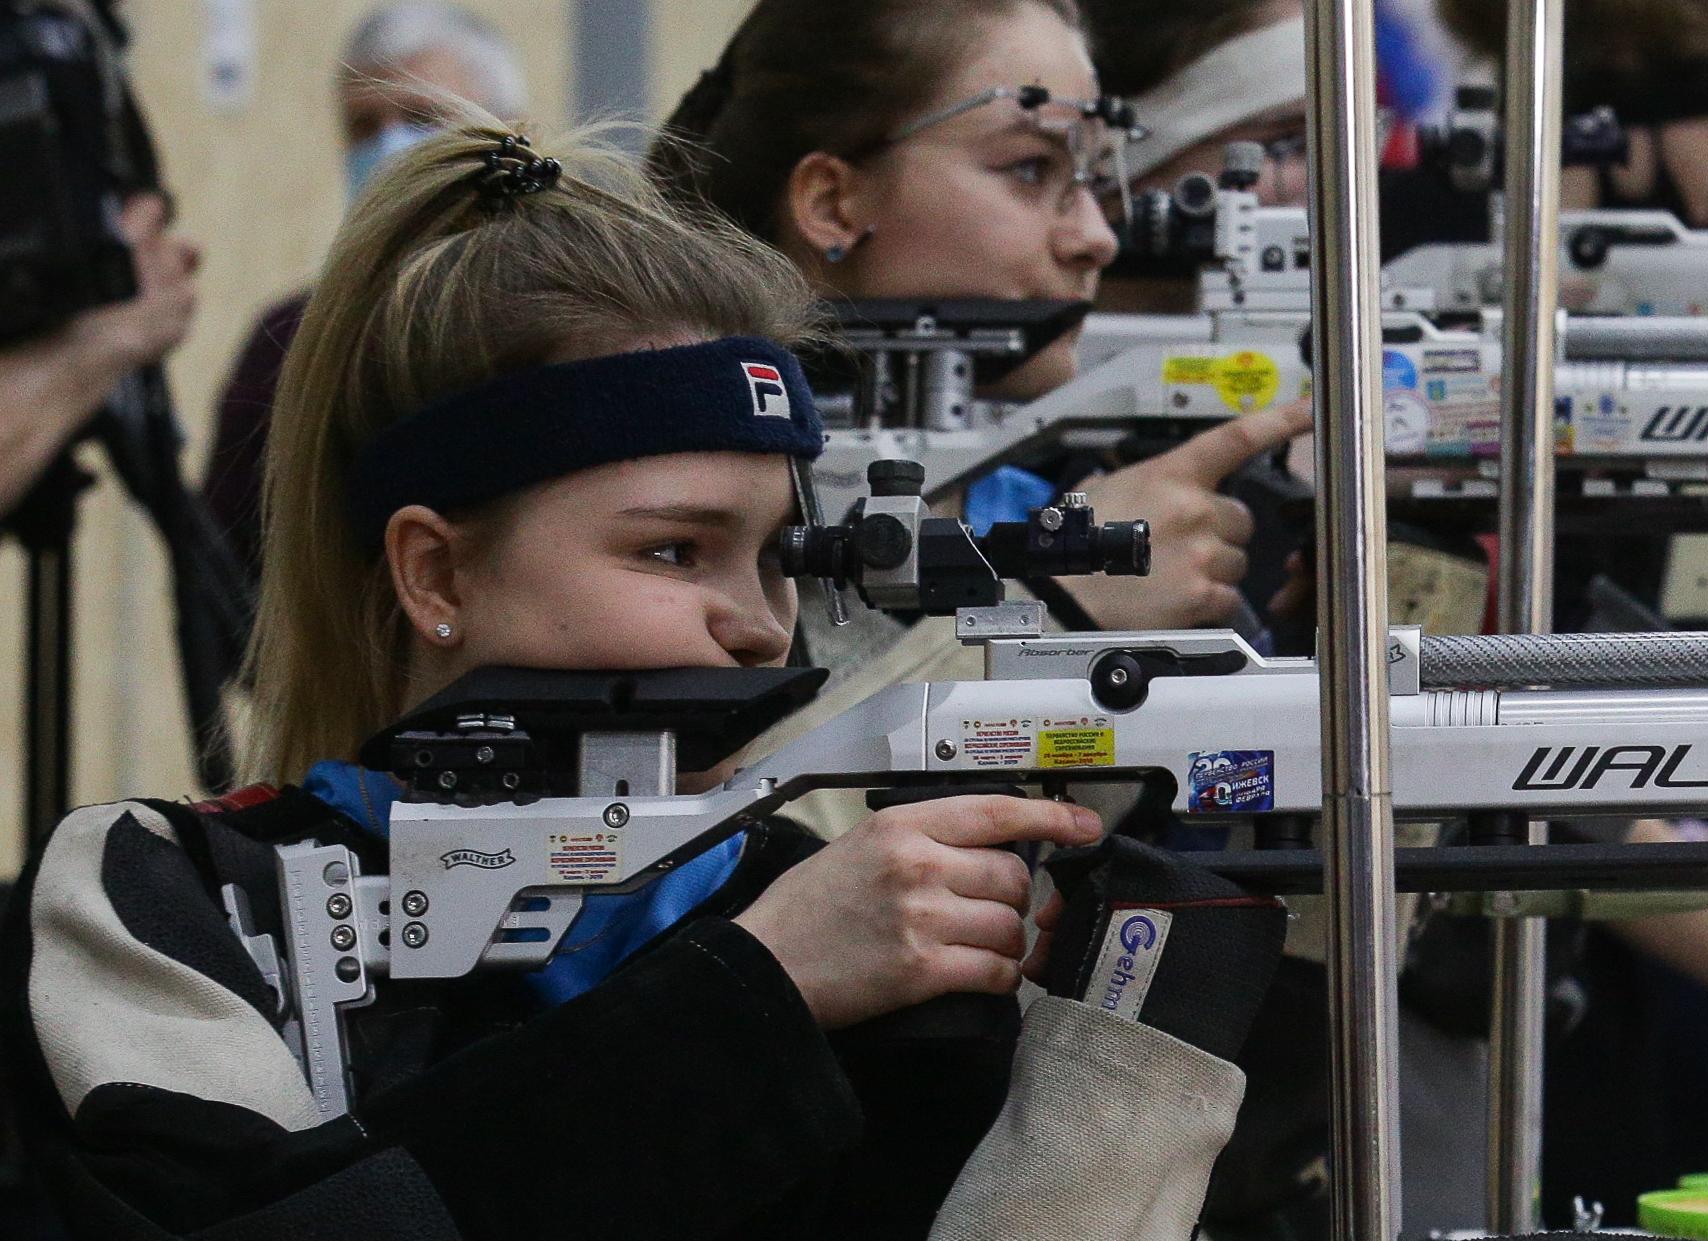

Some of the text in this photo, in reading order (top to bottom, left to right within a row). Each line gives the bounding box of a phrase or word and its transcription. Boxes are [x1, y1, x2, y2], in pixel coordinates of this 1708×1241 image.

[1017, 648, 1095, 657] Absorber
[1232, 775, 1270, 791] ИЖЕВСК
[450, 852, 506, 866] WALTHER
